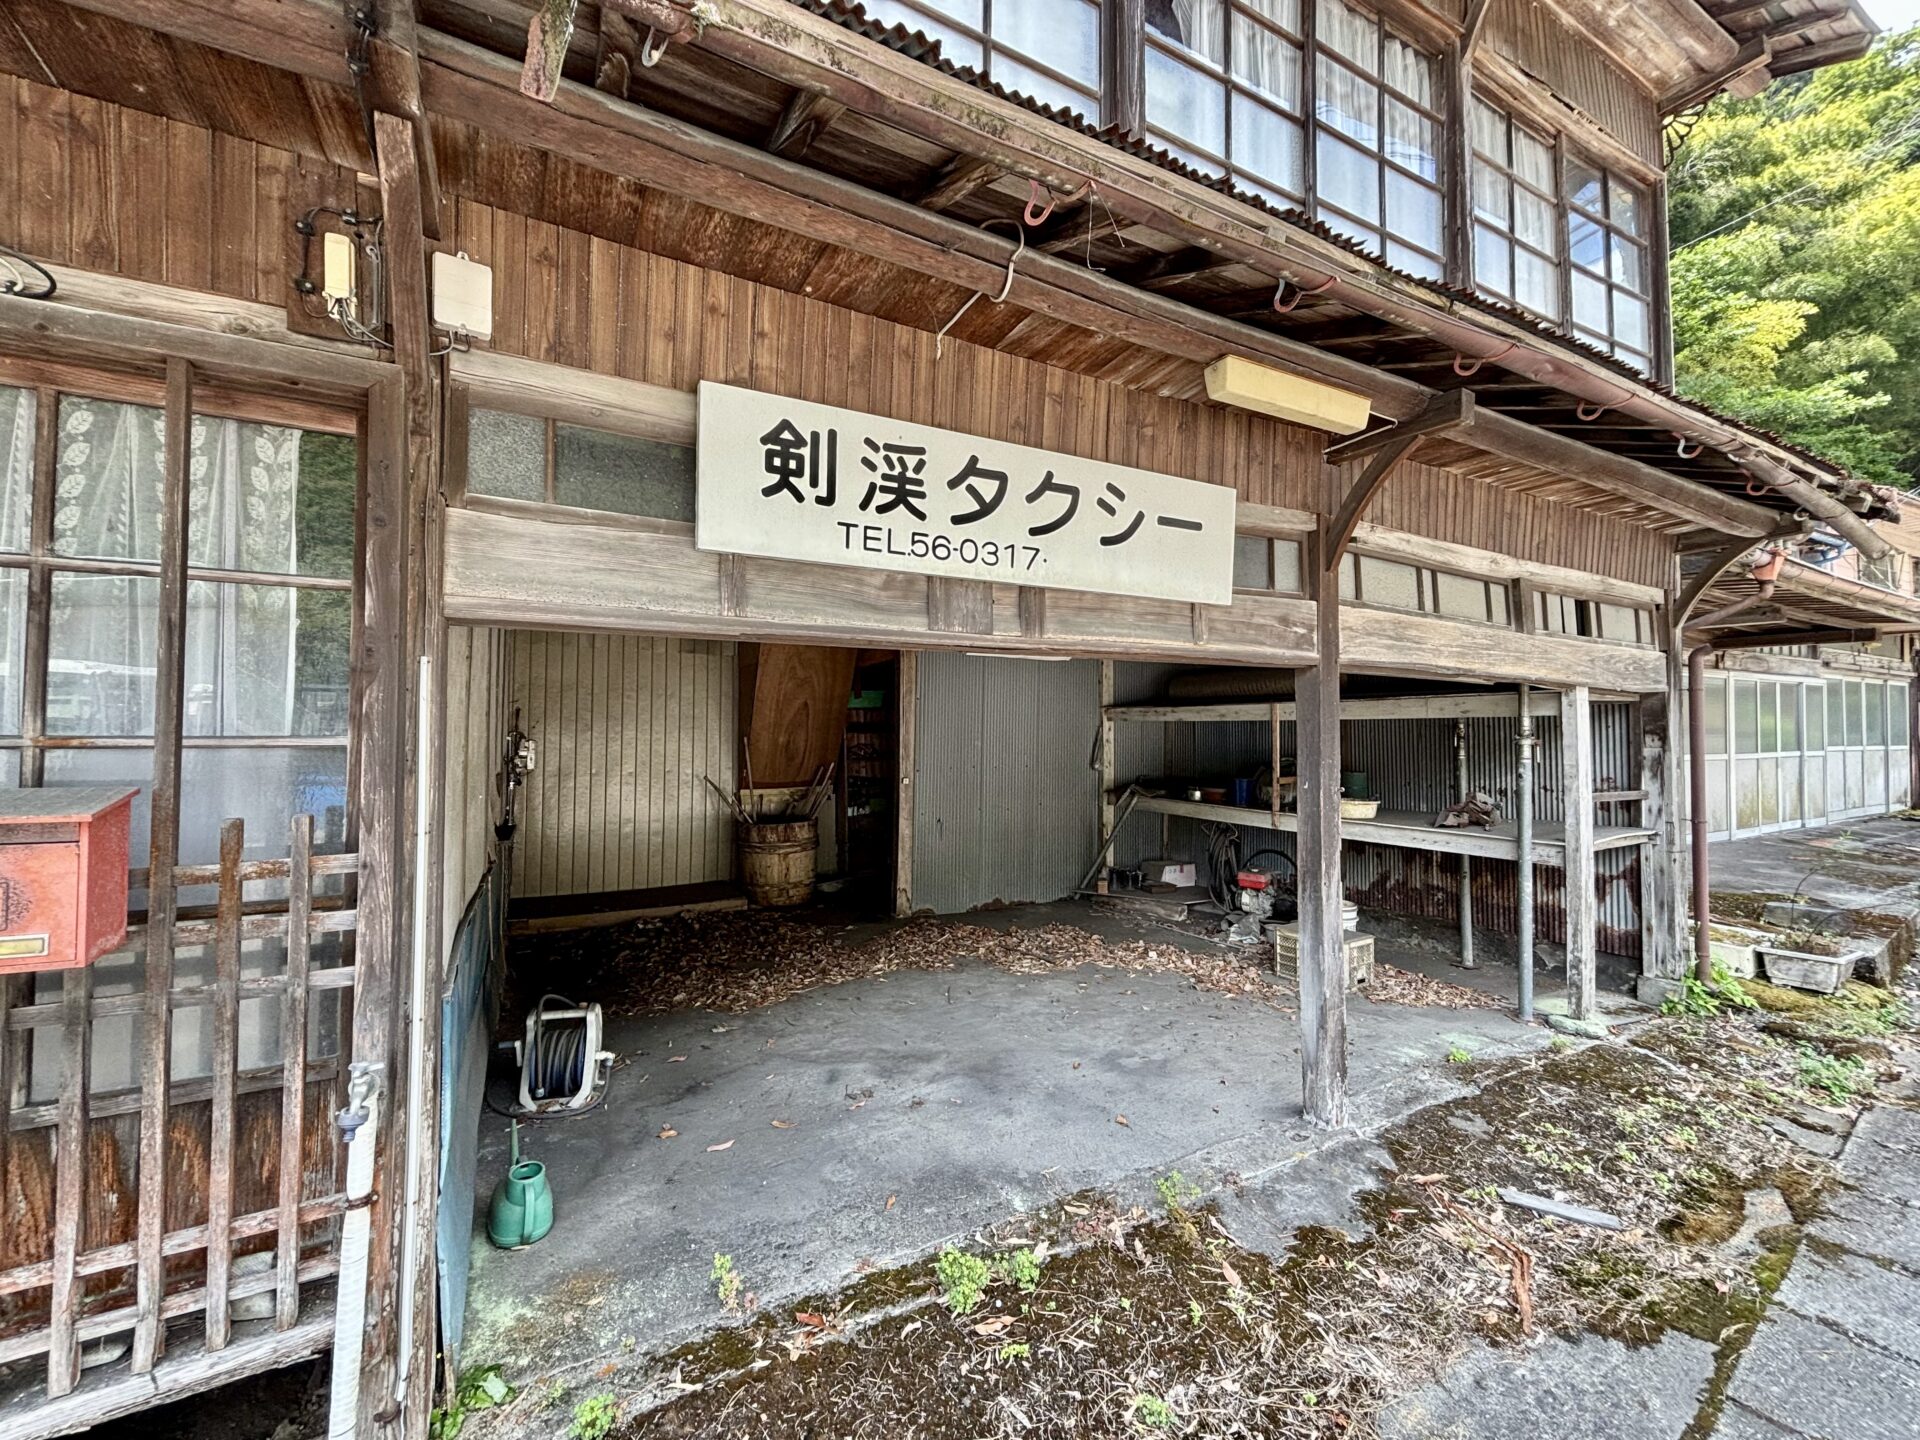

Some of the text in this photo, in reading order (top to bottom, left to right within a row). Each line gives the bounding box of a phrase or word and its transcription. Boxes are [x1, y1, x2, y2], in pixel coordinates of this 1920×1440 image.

[759, 418, 1203, 547] 剣渓タクシー
